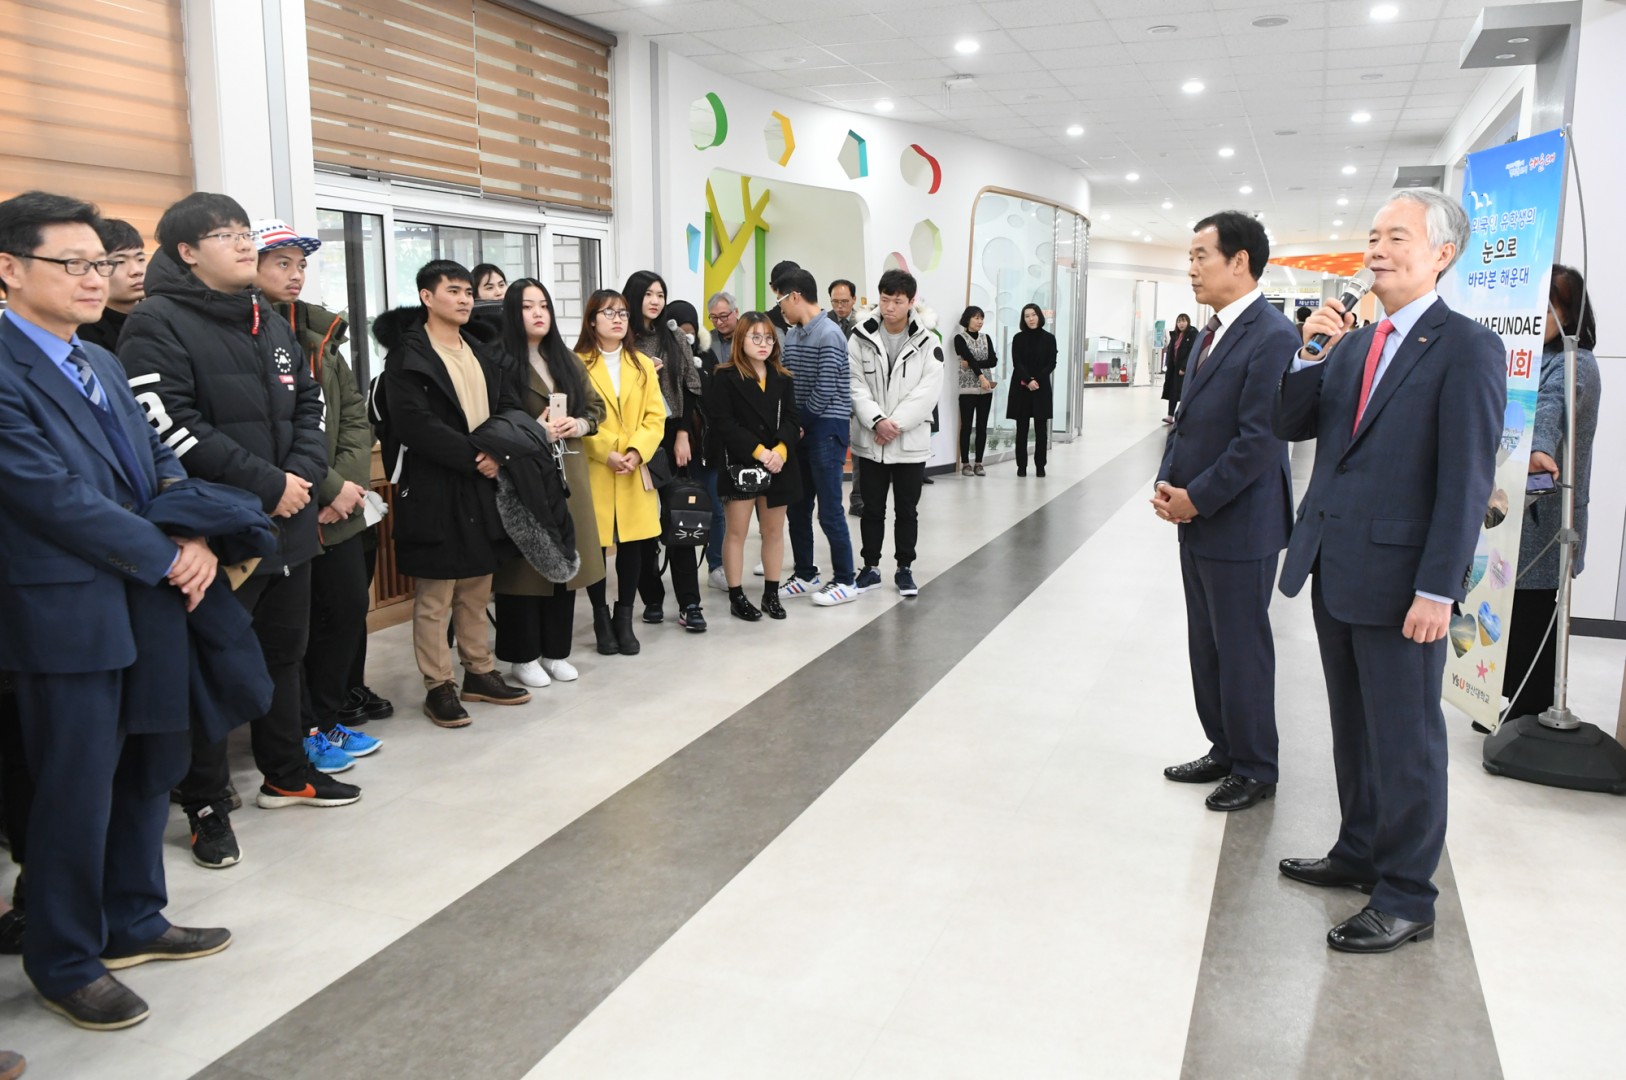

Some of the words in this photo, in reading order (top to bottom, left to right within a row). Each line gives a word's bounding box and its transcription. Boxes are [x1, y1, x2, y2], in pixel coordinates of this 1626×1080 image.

[1471, 215, 1498, 233] 외국인
[1500, 207, 1536, 231] 유학생의
[1482, 238, 1517, 264] 눈으로
[1468, 270, 1497, 290] 바라본
[1500, 267, 1530, 288] 해운대
